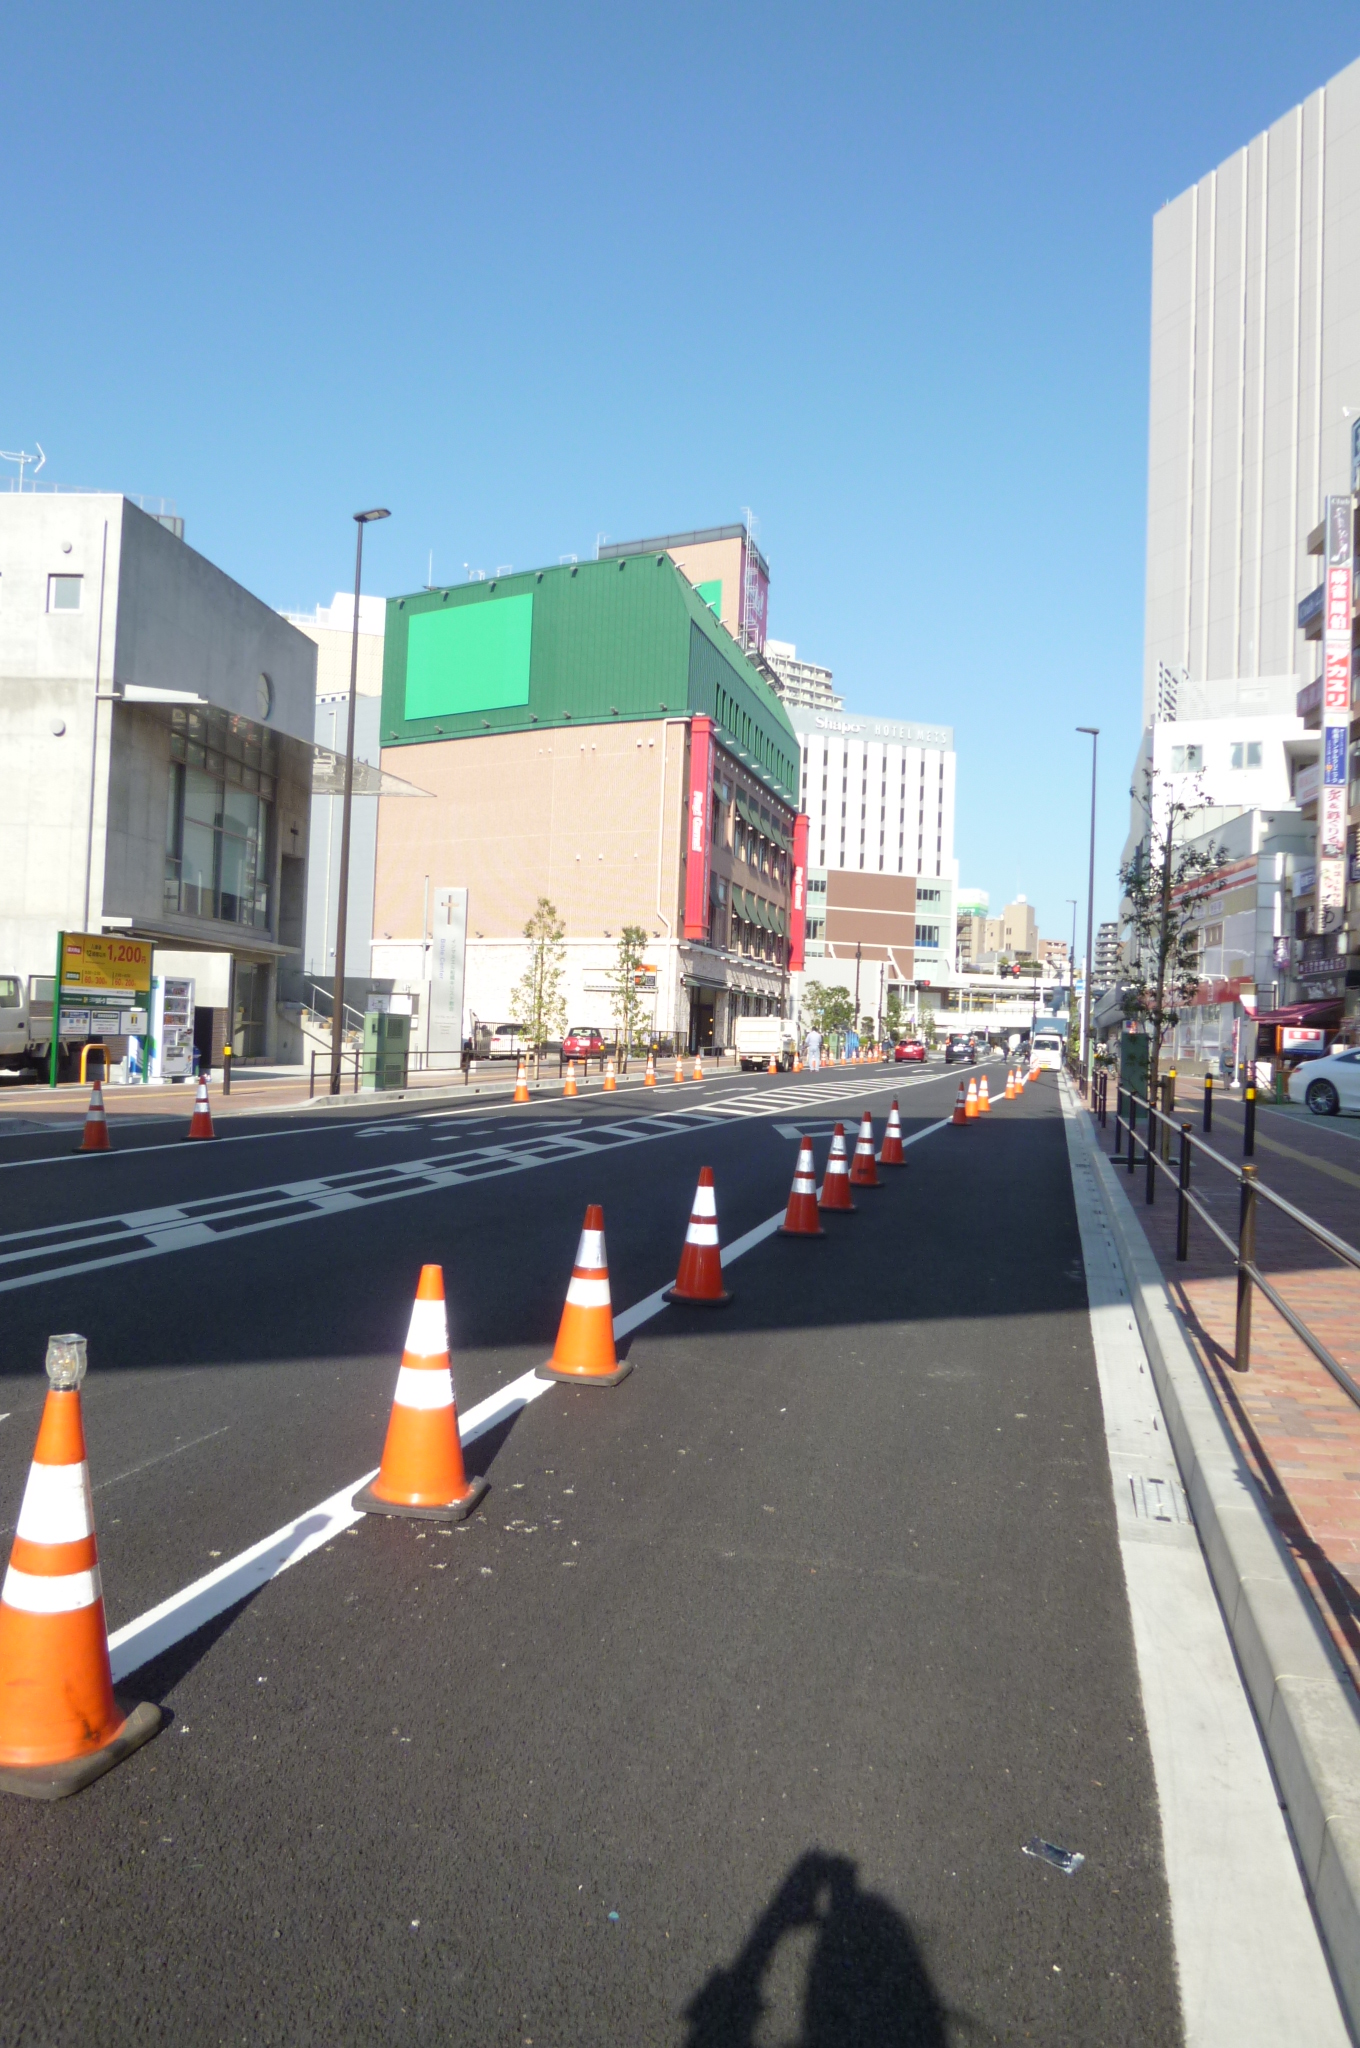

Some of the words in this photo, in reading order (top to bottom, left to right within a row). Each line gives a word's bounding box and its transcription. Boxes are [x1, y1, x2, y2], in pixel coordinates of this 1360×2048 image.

[1327, 651, 1349, 706] アカスリ
[875, 724, 912, 740] HOTEL
[917, 730, 948, 745] METS
